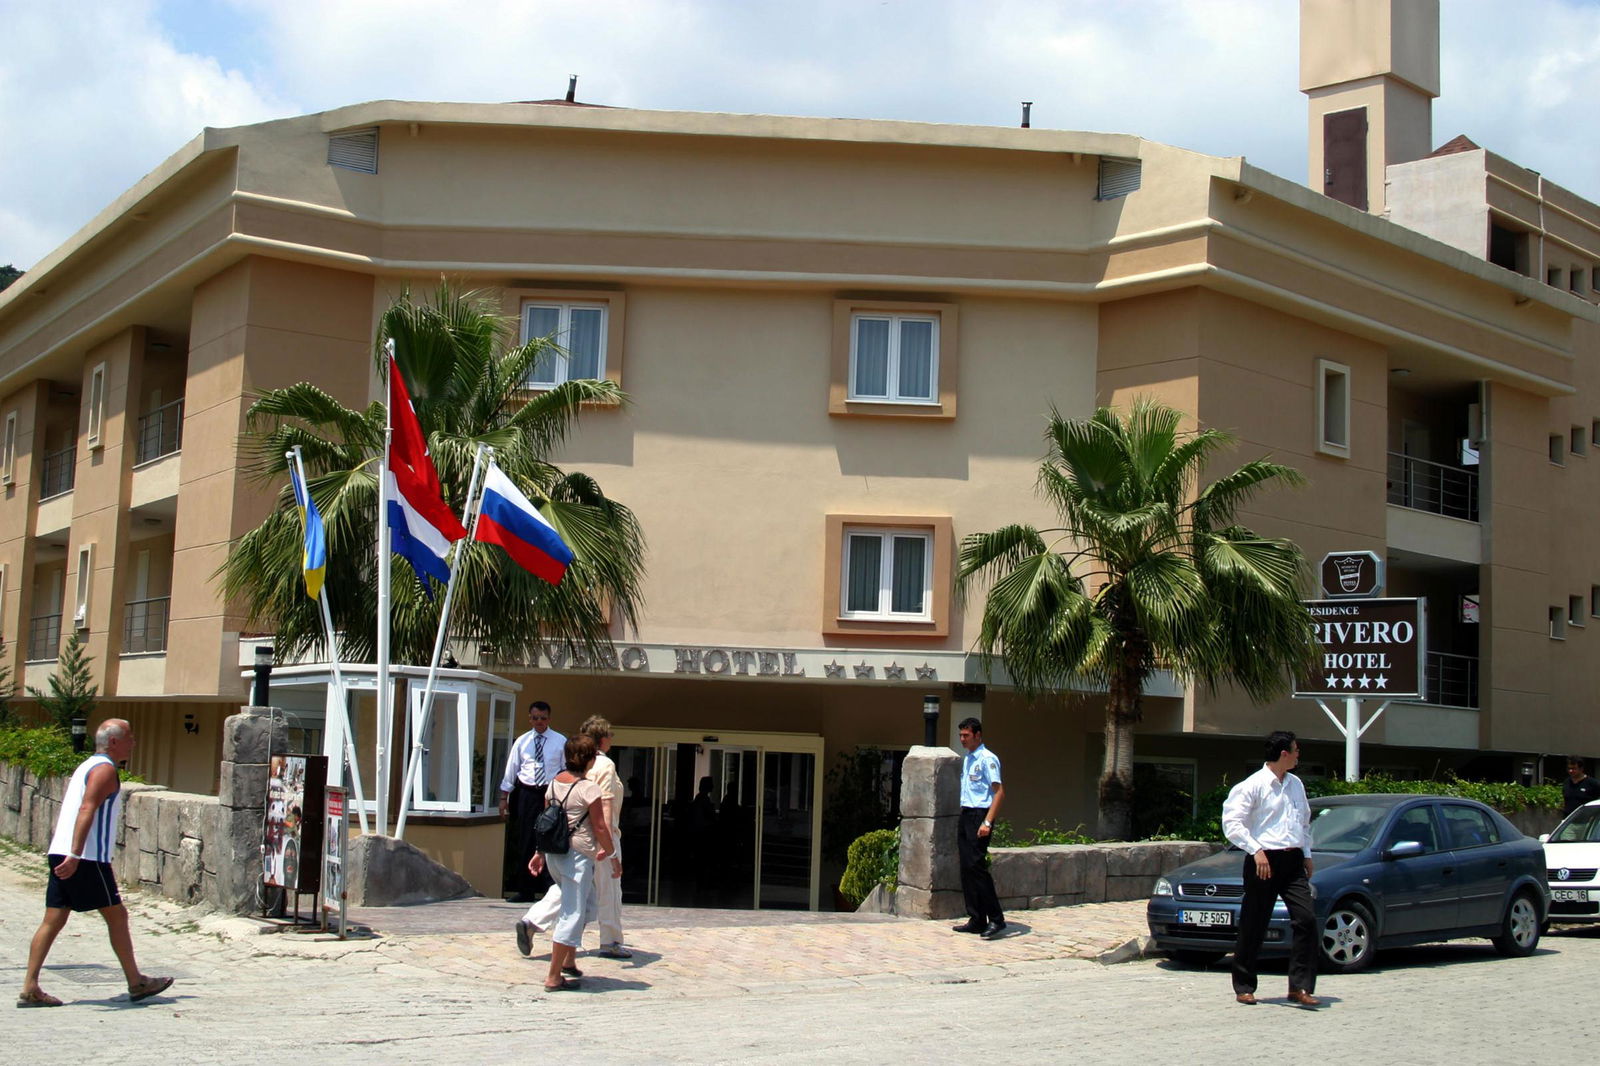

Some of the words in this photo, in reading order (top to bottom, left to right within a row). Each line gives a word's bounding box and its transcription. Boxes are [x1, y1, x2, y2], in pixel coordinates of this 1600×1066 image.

[674, 648, 805, 676] HOTEL
[1324, 653, 1391, 669] HOTEL
[1554, 890, 1574, 900] CEC
[1184, 911, 1193, 922] 34
[1199, 911, 1209, 923] ZF
[1210, 912, 1230, 924] 5057
